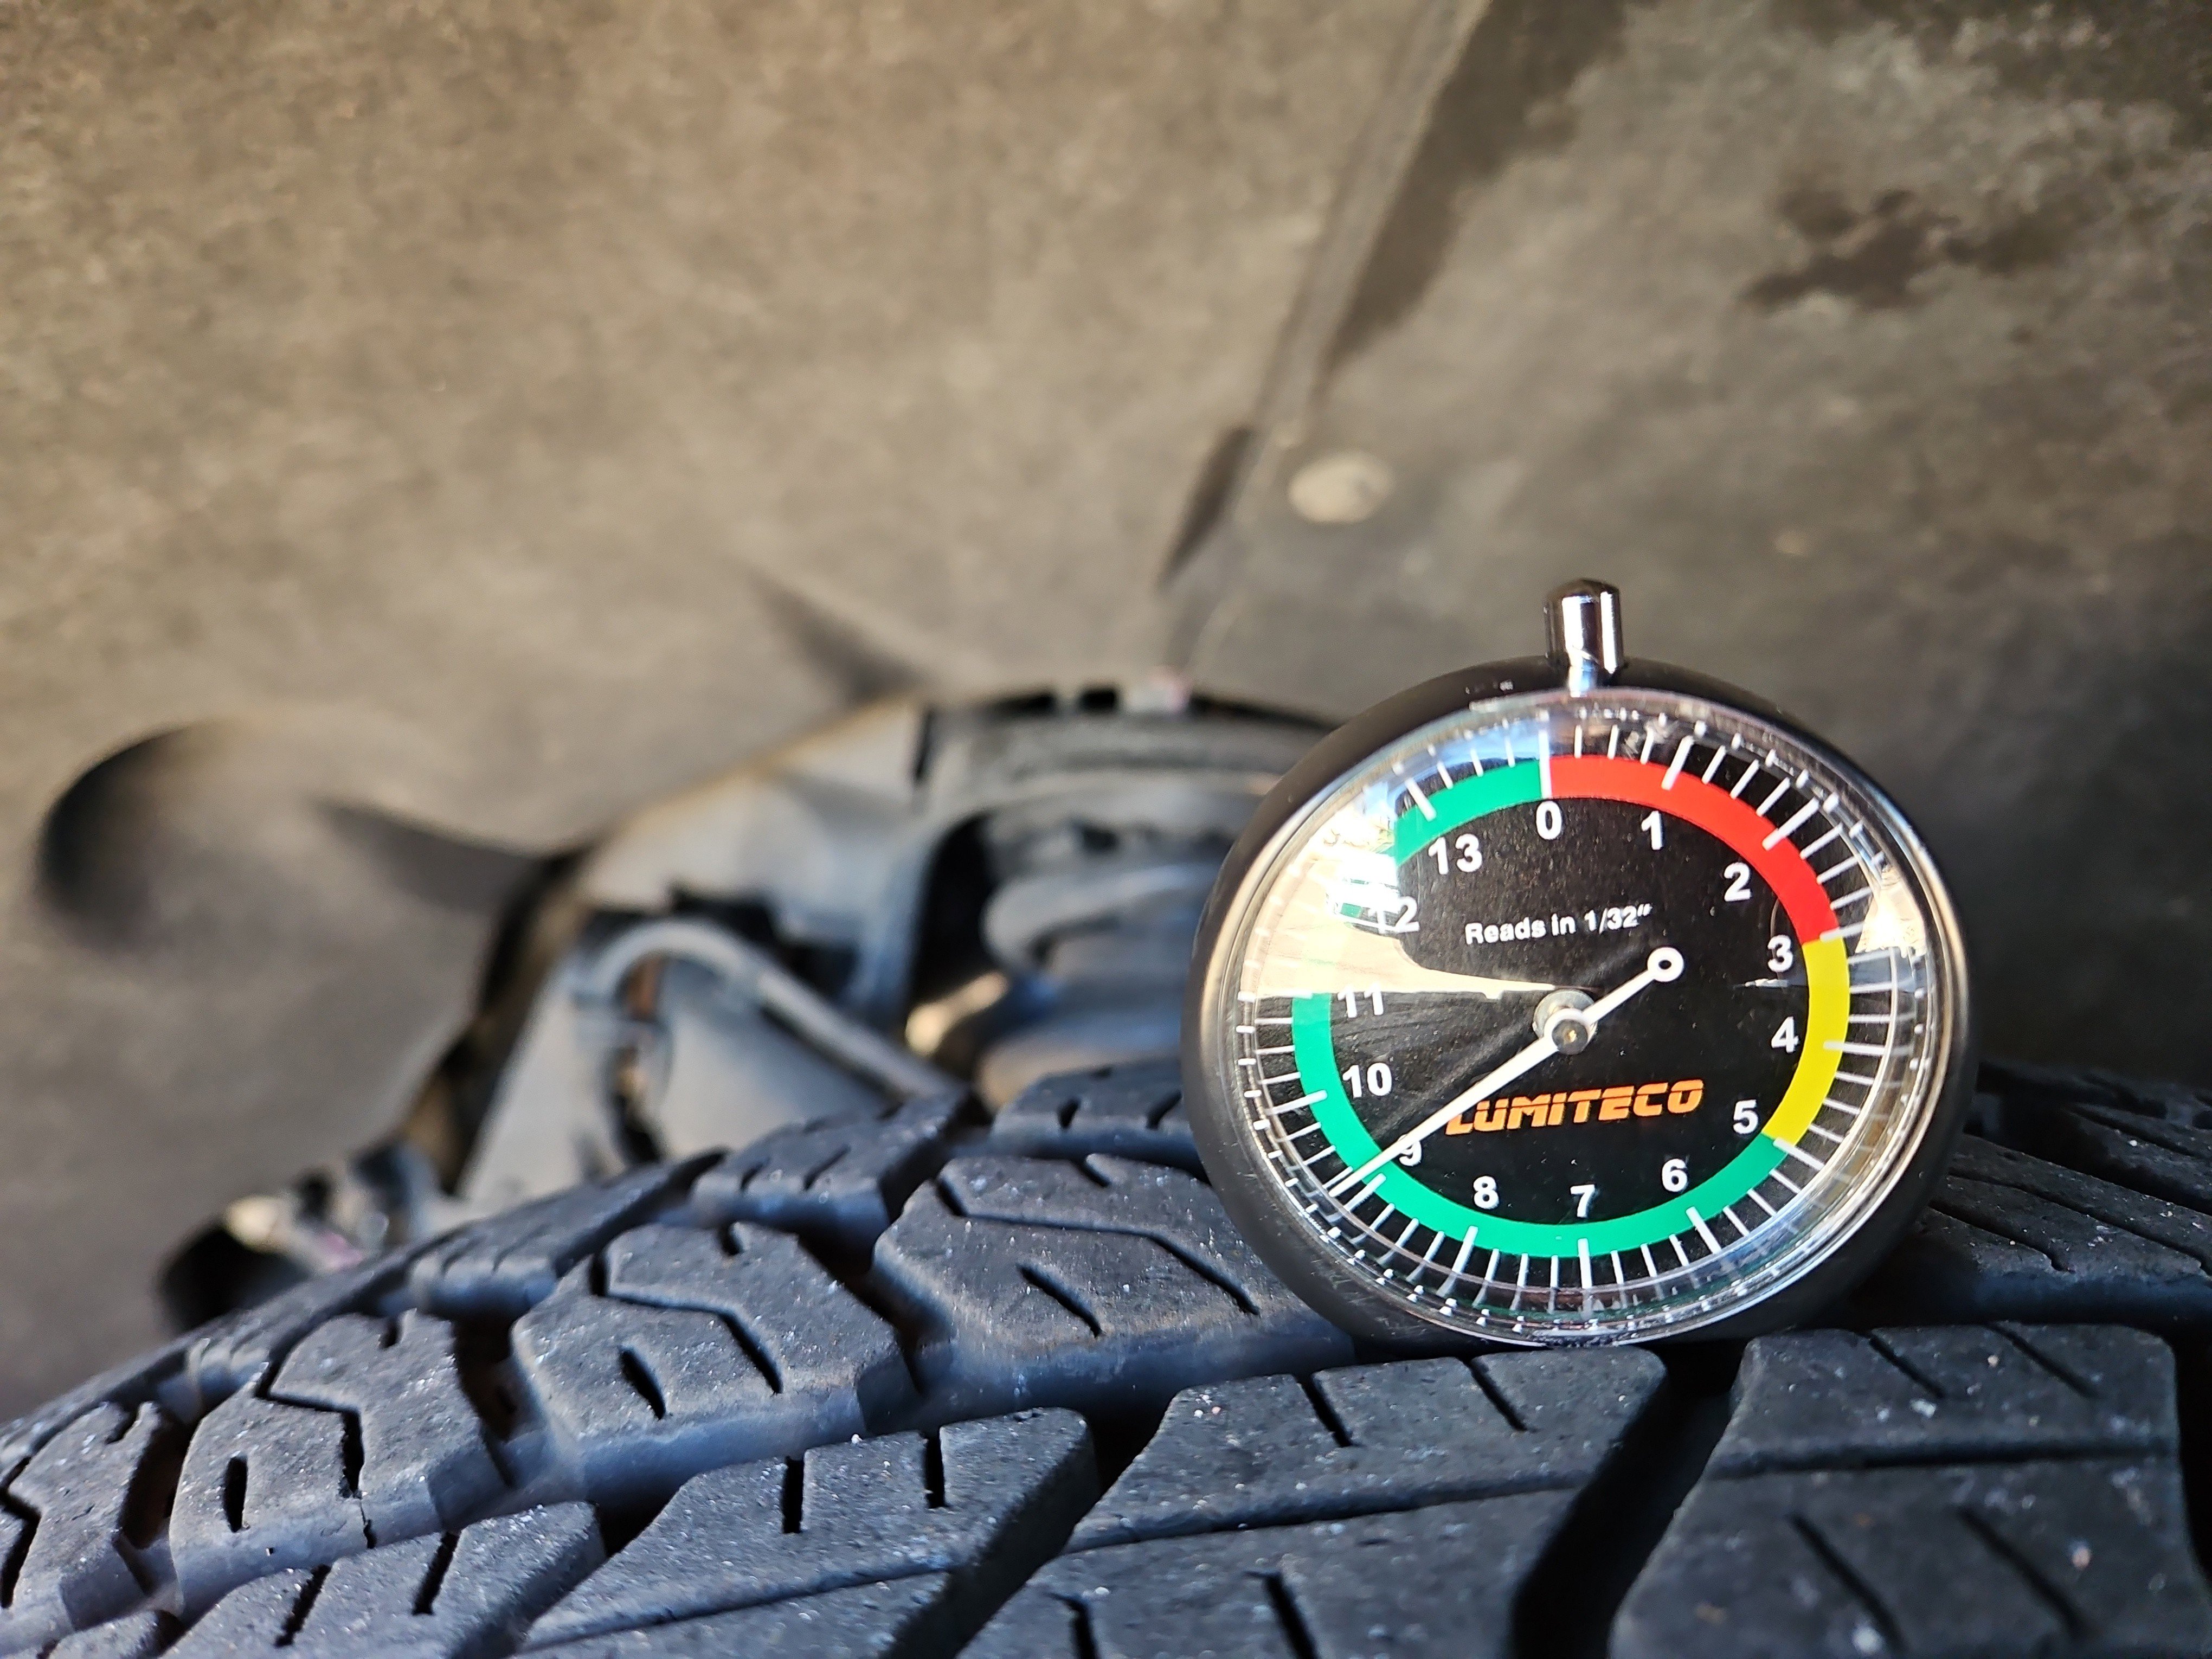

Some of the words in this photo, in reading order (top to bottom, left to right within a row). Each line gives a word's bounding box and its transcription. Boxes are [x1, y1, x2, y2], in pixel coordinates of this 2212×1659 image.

[1535, 801, 1563, 840] 0
[1641, 811, 1663, 850] 1
[1428, 834, 1483, 874] 13
[1724, 862, 1752, 902] 2
[1465, 917, 1546, 944] Reads
[1584, 903, 1652, 935] 1/32"
[1767, 935, 1793, 972] 3
[1337, 982, 1384, 1018] 11
[1771, 1017, 1799, 1053] 4
[1342, 1062, 1392, 1098] 10
[1445, 1079, 1703, 1136] LUMITECO
[1733, 1099, 1759, 1134] 5
[1472, 1175, 1500, 1209] 8
[1662, 1159, 1688, 1193] 6
[1570, 1184, 1596, 1218] 7
